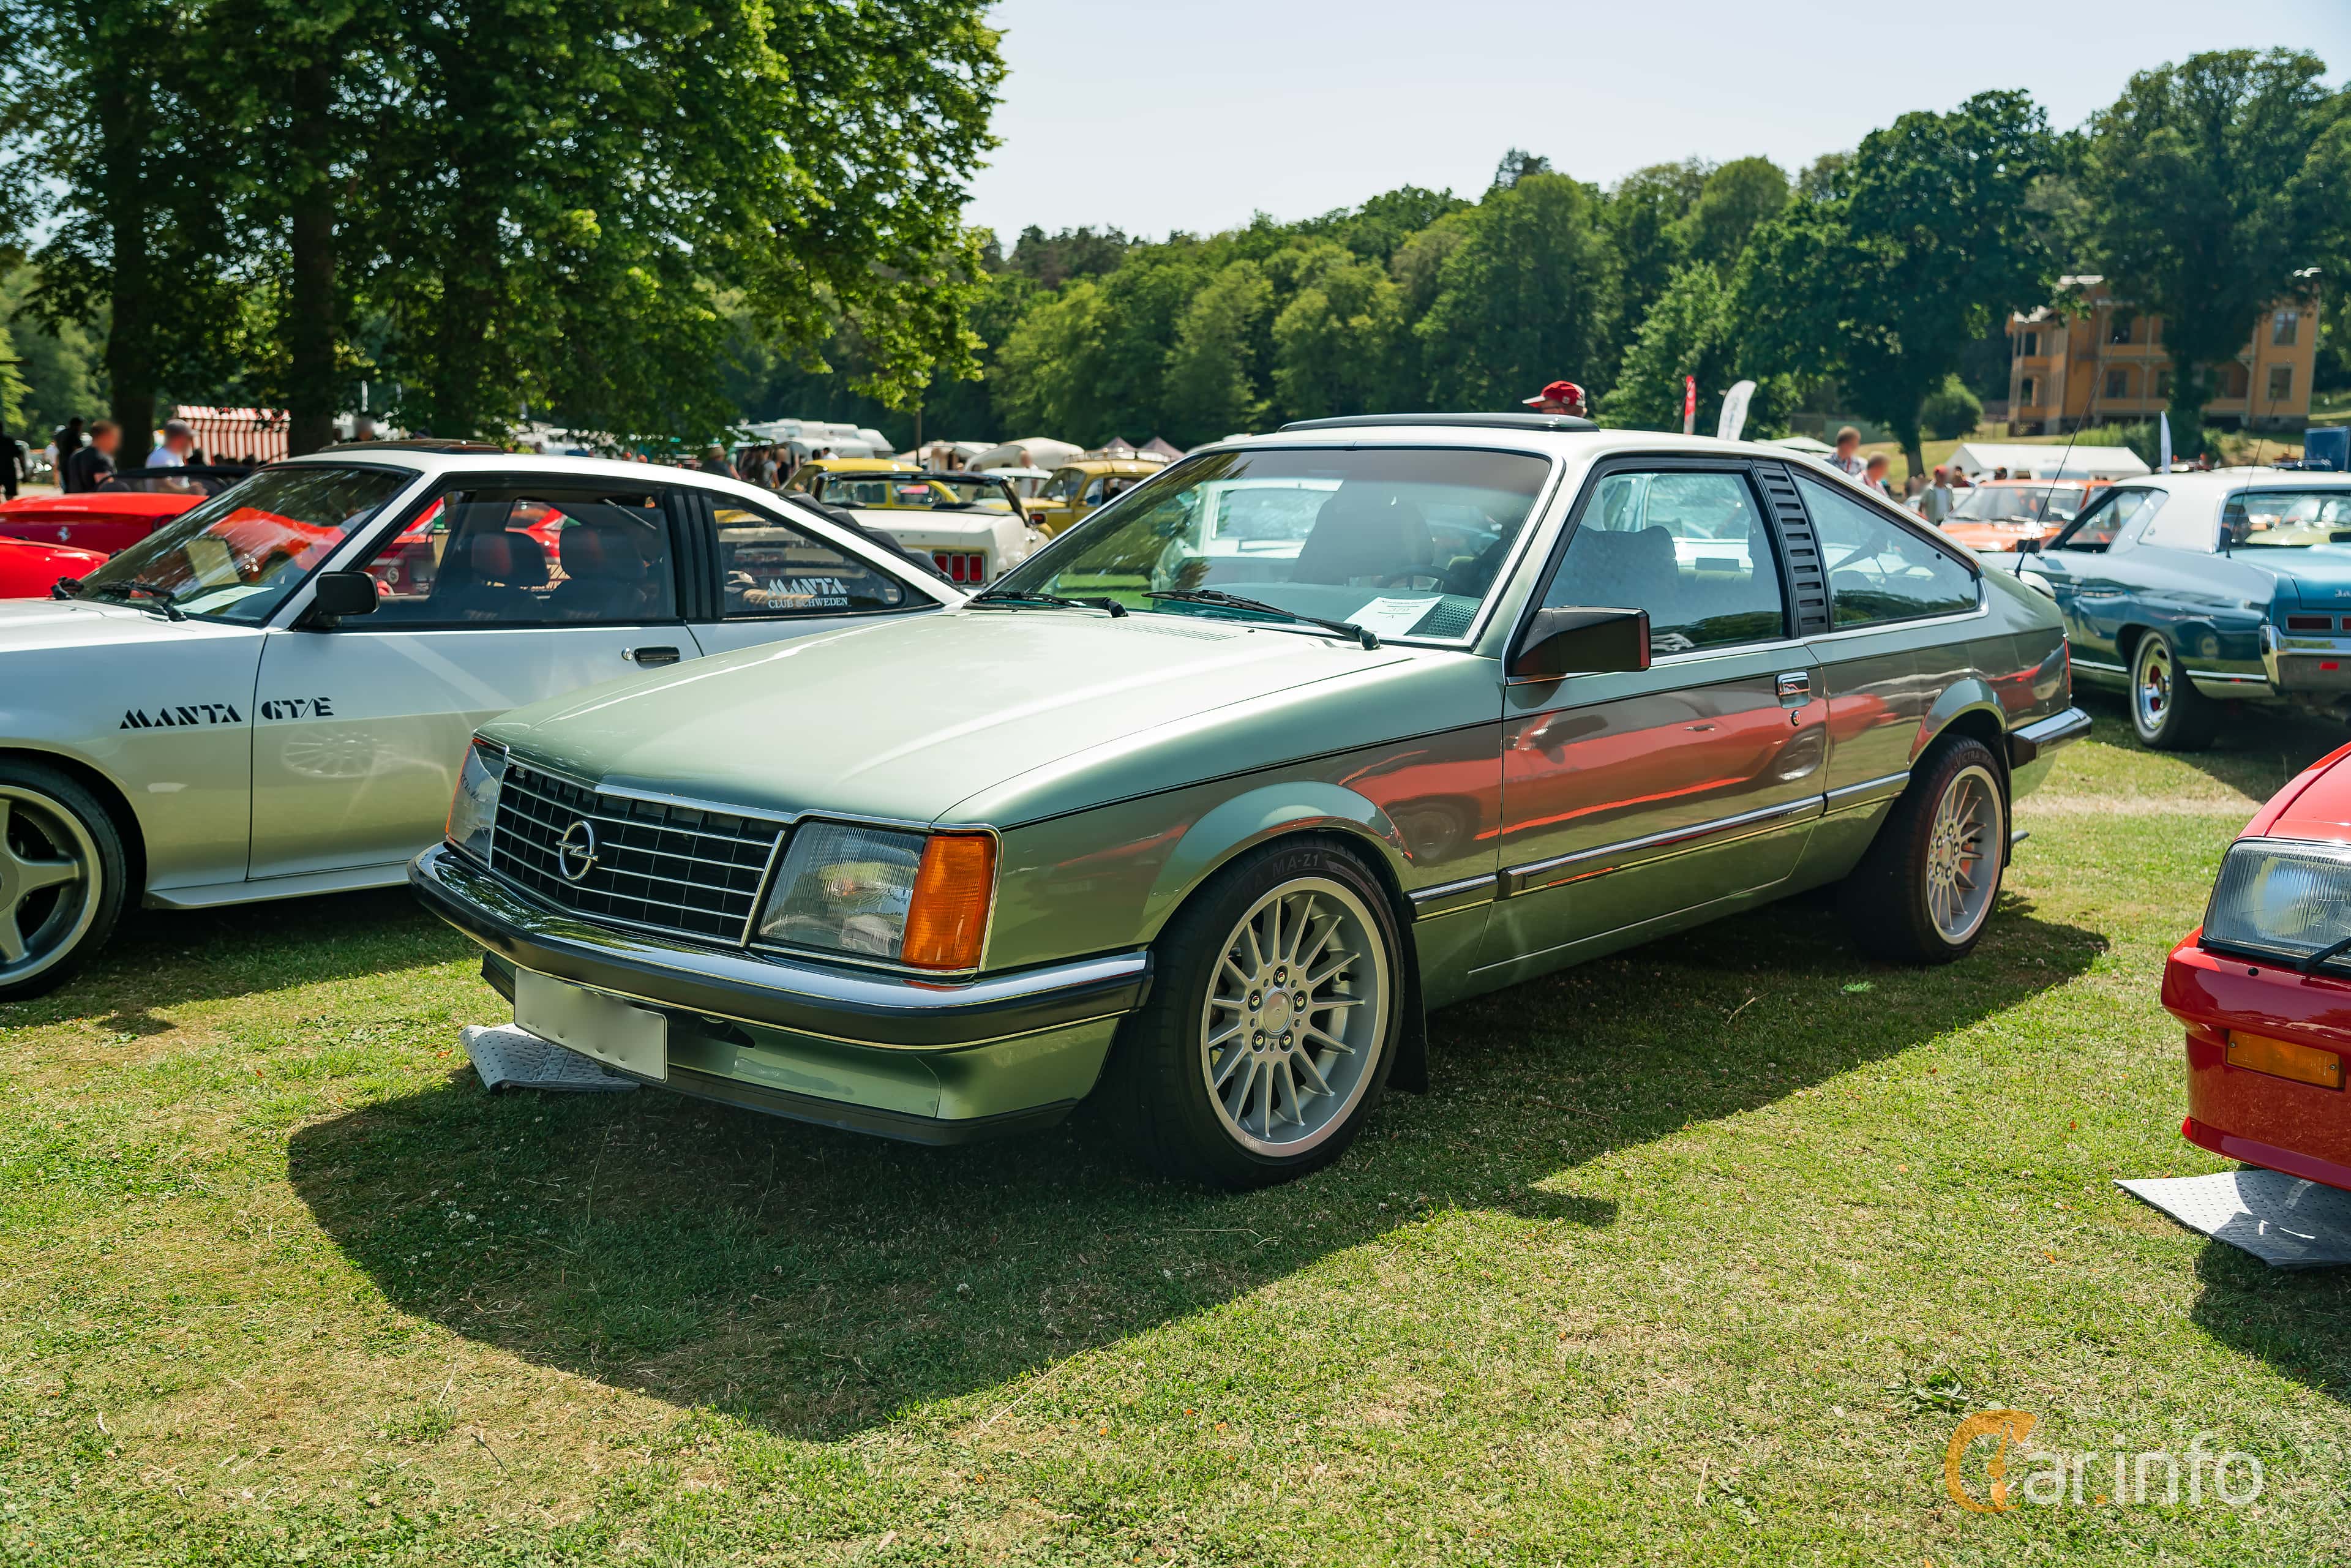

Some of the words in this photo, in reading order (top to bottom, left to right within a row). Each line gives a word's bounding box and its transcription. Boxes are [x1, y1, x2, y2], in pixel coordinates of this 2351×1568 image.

[767, 577, 847, 597] MANTA
[768, 599, 794, 609] CLUB
[796, 597, 849, 607] SCHWEDEN
[119, 703, 242, 729] MANTA
[261, 697, 335, 720] GT/E
[1273, 853, 1319, 876] MA-Z1
